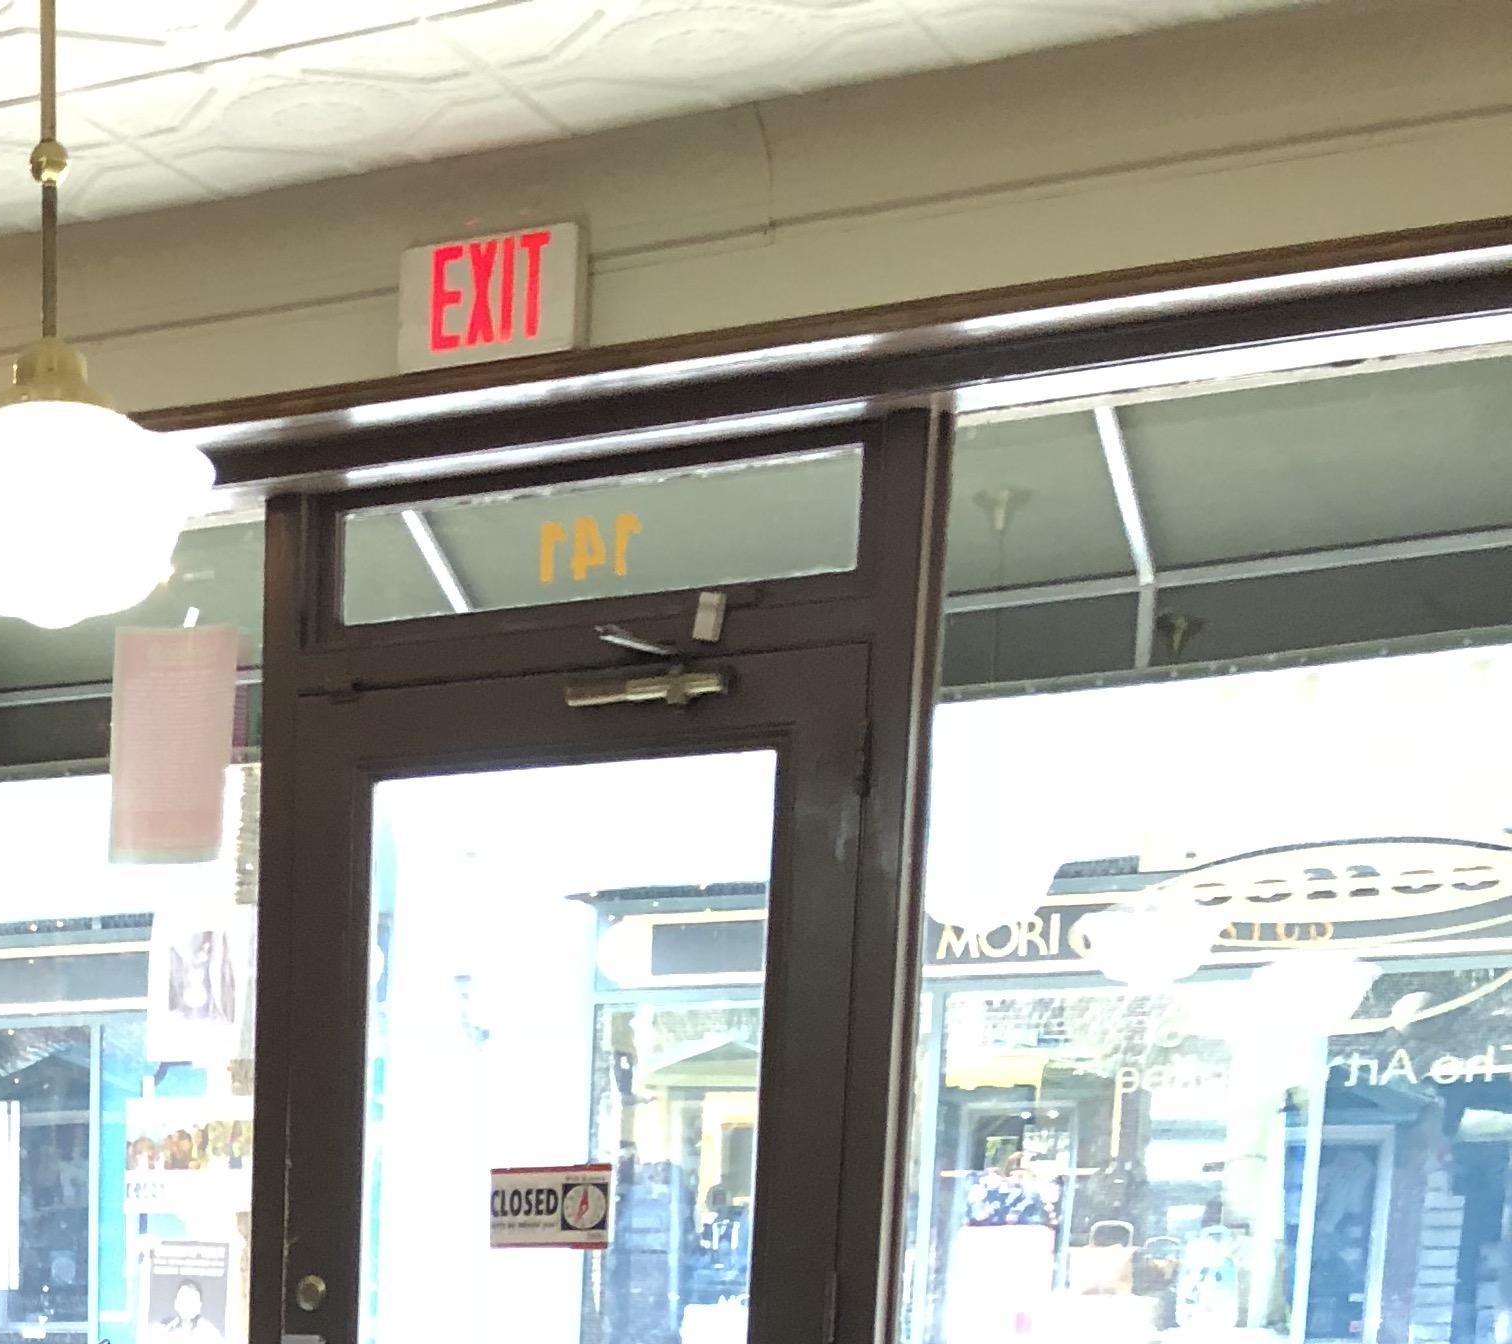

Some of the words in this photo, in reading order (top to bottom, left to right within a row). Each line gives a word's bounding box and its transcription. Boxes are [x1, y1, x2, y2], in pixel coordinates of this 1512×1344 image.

[430, 231, 552, 351] EXIT
[936, 914, 1061, 960] MORI
[490, 1188, 559, 1217] CLOSED
